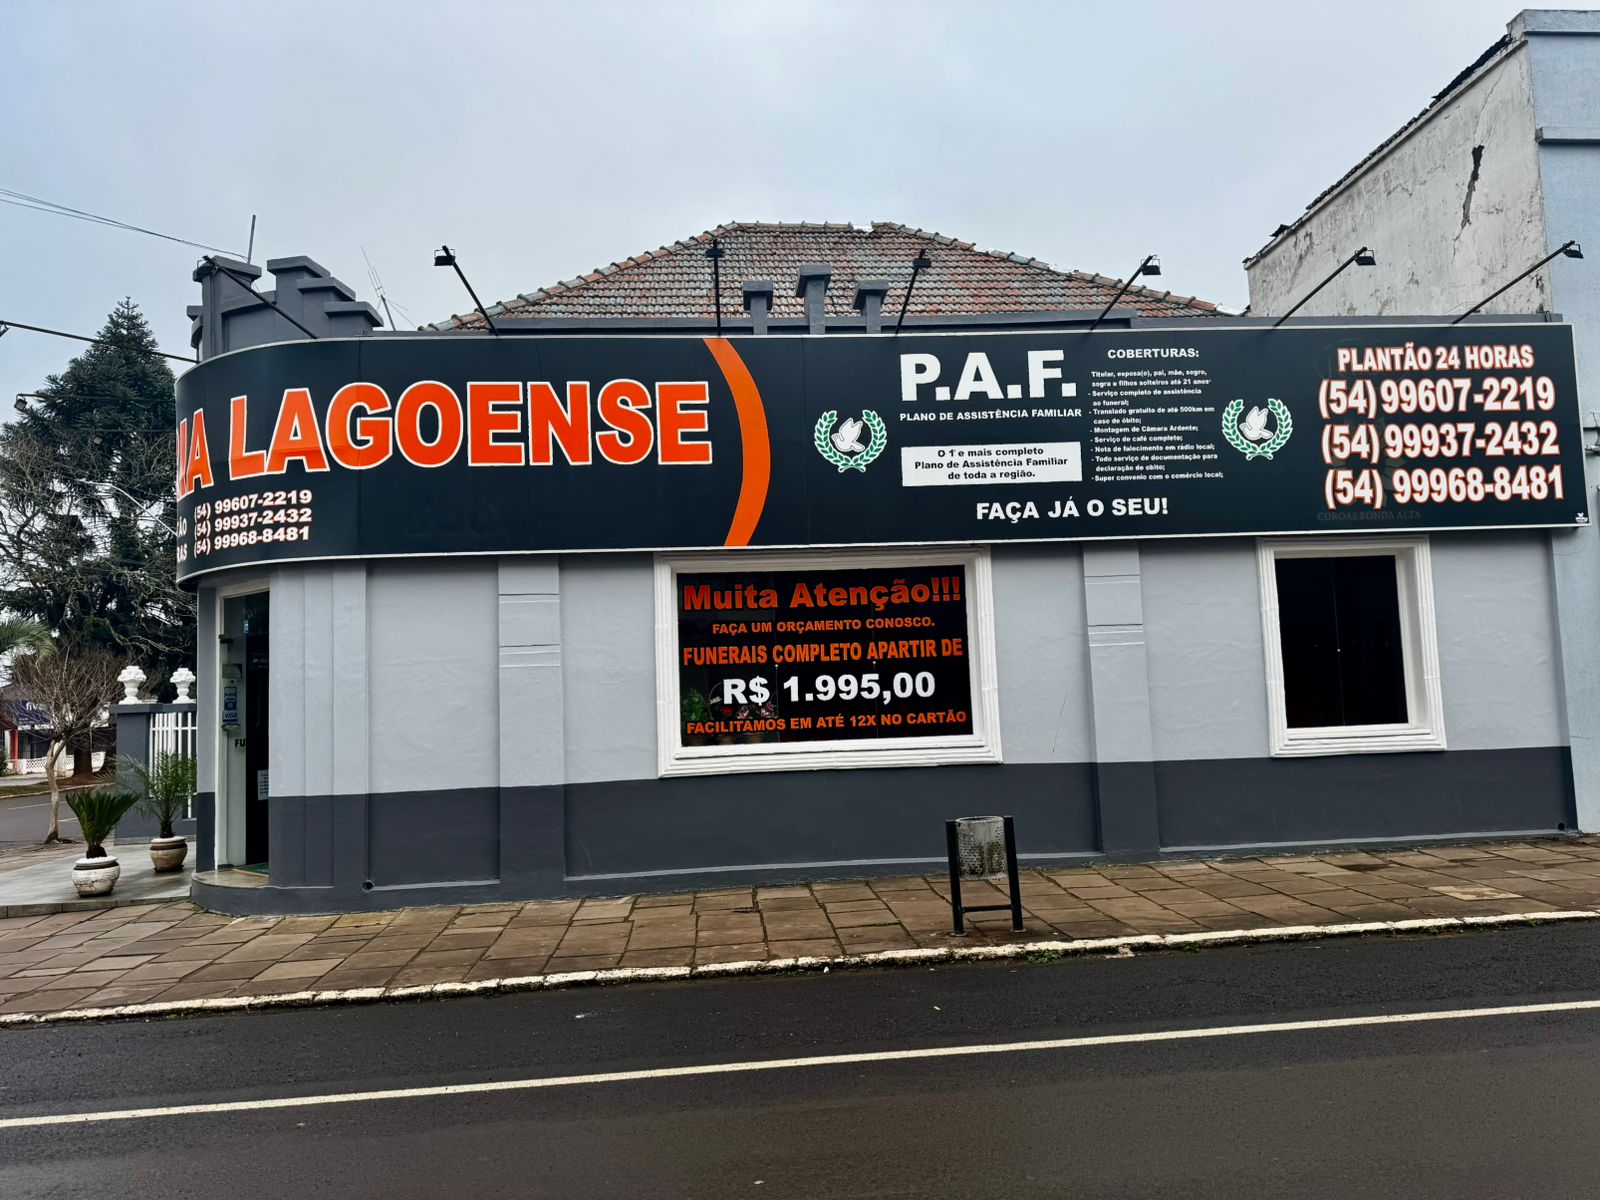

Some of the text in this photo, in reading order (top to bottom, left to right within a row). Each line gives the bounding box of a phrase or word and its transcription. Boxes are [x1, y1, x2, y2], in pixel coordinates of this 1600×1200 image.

[1108, 348, 1199, 358] COBERTURAS:
[1337, 342, 1534, 372] PLANTÃO 24 HORAS
[899, 349, 1077, 402] P.A.F.
[1318, 376, 1556, 418] (54) 99607-2219
[900, 413, 936, 421] PLANO
[957, 409, 1028, 420] ASSISTÊNCIA
[1032, 409, 1082, 417] FAMILIAR
[228, 379, 714, 481] LAGOENSE
[1320, 420, 1560, 464] (54) 99937-2432
[915, 461, 943, 469] Plano
[963, 459, 1022, 468] Assistência
[1026, 458, 1068, 466] Familiar
[996, 448, 1044, 457] completo
[1151, 453, 1200, 461] documentação
[948, 472, 961, 480] de
[1000, 470, 1035, 480] região.
[1096, 464, 1133, 472] declaração
[1324, 464, 1564, 509] (54) 99968-8481
[194, 490, 312, 522] (54) 99607-2219
[976, 496, 1169, 523] FAÇA JÁ O SEU!
[194, 521, 211, 540] (54)
[215, 508, 312, 532] 99937-2432
[193, 526, 309, 558] (54) 99968-8481
[683, 576, 961, 610] Muita Atenção!!!
[712, 617, 935, 636] FAÇA UM ORÇAMENTO CONOSCO.
[683, 639, 963, 666] FUNERAIS COMPLETO APARTIR DE
[723, 672, 935, 706] R$ 1.995,00
[687, 710, 967, 734] FACILITAMOS EM ATÉ 12X NO CARTÃO
